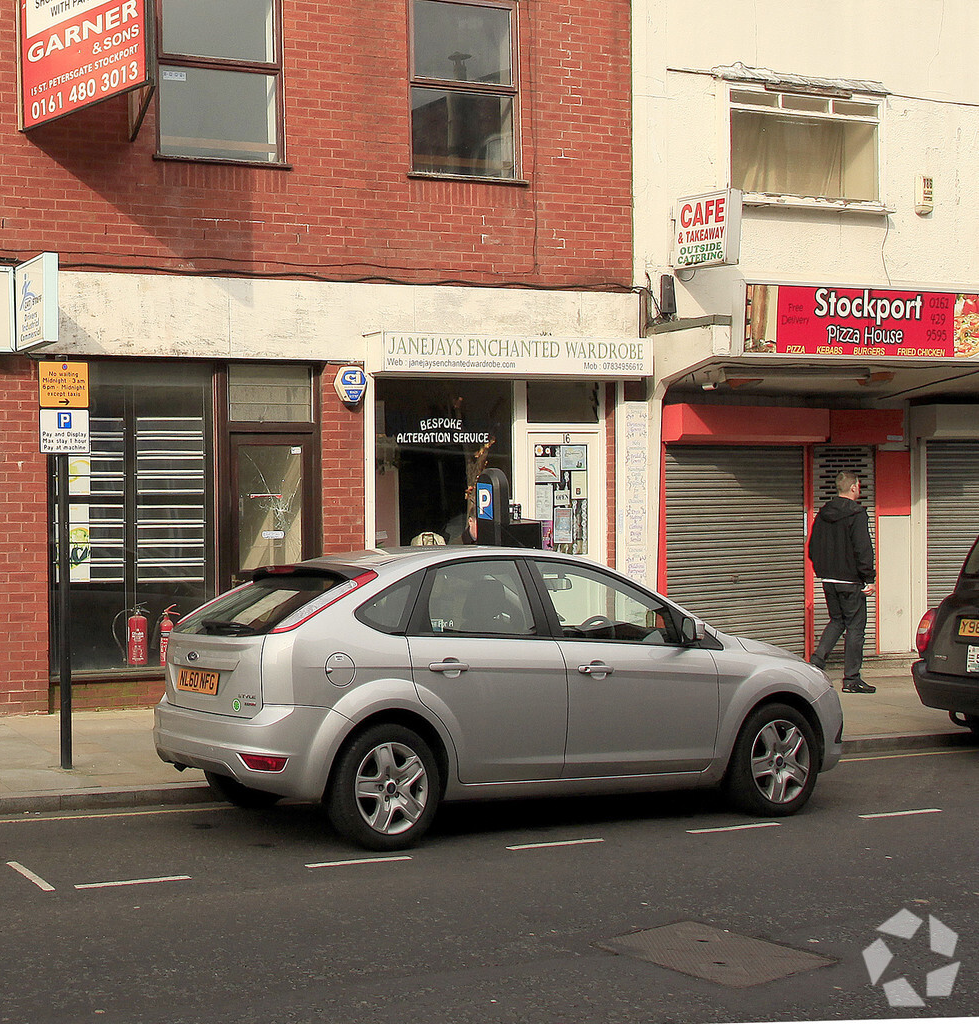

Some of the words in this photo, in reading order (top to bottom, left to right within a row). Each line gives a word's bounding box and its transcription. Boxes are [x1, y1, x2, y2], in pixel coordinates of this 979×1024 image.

[27, 0, 139, 63] GARNER
[103, 24, 140, 51] SONS
[30, 82, 38, 96] 15
[38, 78, 48, 93] ST.
[48, 63, 93, 89] PETERSGATE
[94, 43, 139, 70] STOCKPORT
[31, 91, 63, 120] 0161
[68, 78, 96, 104] 480
[101, 60, 138, 92] 3013
[681, 198, 725, 228] CAFE
[678, 232, 684, 244] &
[685, 226, 725, 243] TAKEAWAY
[680, 241, 722, 255] OUTSIDE
[677, 251, 723, 264] CATERING
[788, 303, 803, 313] Free
[814, 288, 922, 325] Stockport
[929, 297, 949, 309] 0161
[781, 315, 810, 326] Delivery
[930, 314, 946, 326] 429
[826, 325, 860, 344] Pizza
[864, 327, 904, 345] House
[926, 329, 947, 342] 9595
[387, 336, 463, 356] JANEJAYS
[467, 338, 560, 358] ENCHANTED
[565, 341, 644, 360] WARDROBE
[786, 345, 806, 354] PIZZA
[816, 346, 843, 355] KEBABS
[853, 346, 886, 356] BURGERS
[897, 347, 916, 356] FRIED
[916, 348, 946, 357] CHICKEN
[386, 357, 404, 366] Web
[408, 359, 516, 369] janejaysenchantedwardrobe.com
[583, 362, 598, 370] Mob
[60, 413, 70, 428] P
[420, 417, 463, 431] BESPOKE
[396, 432, 451, 444] ALTERATION
[452, 432, 490, 443] SERVICE
[562, 433, 570, 444] 16
[478, 488, 492, 515] P
[180, 670, 199, 688] NL60
